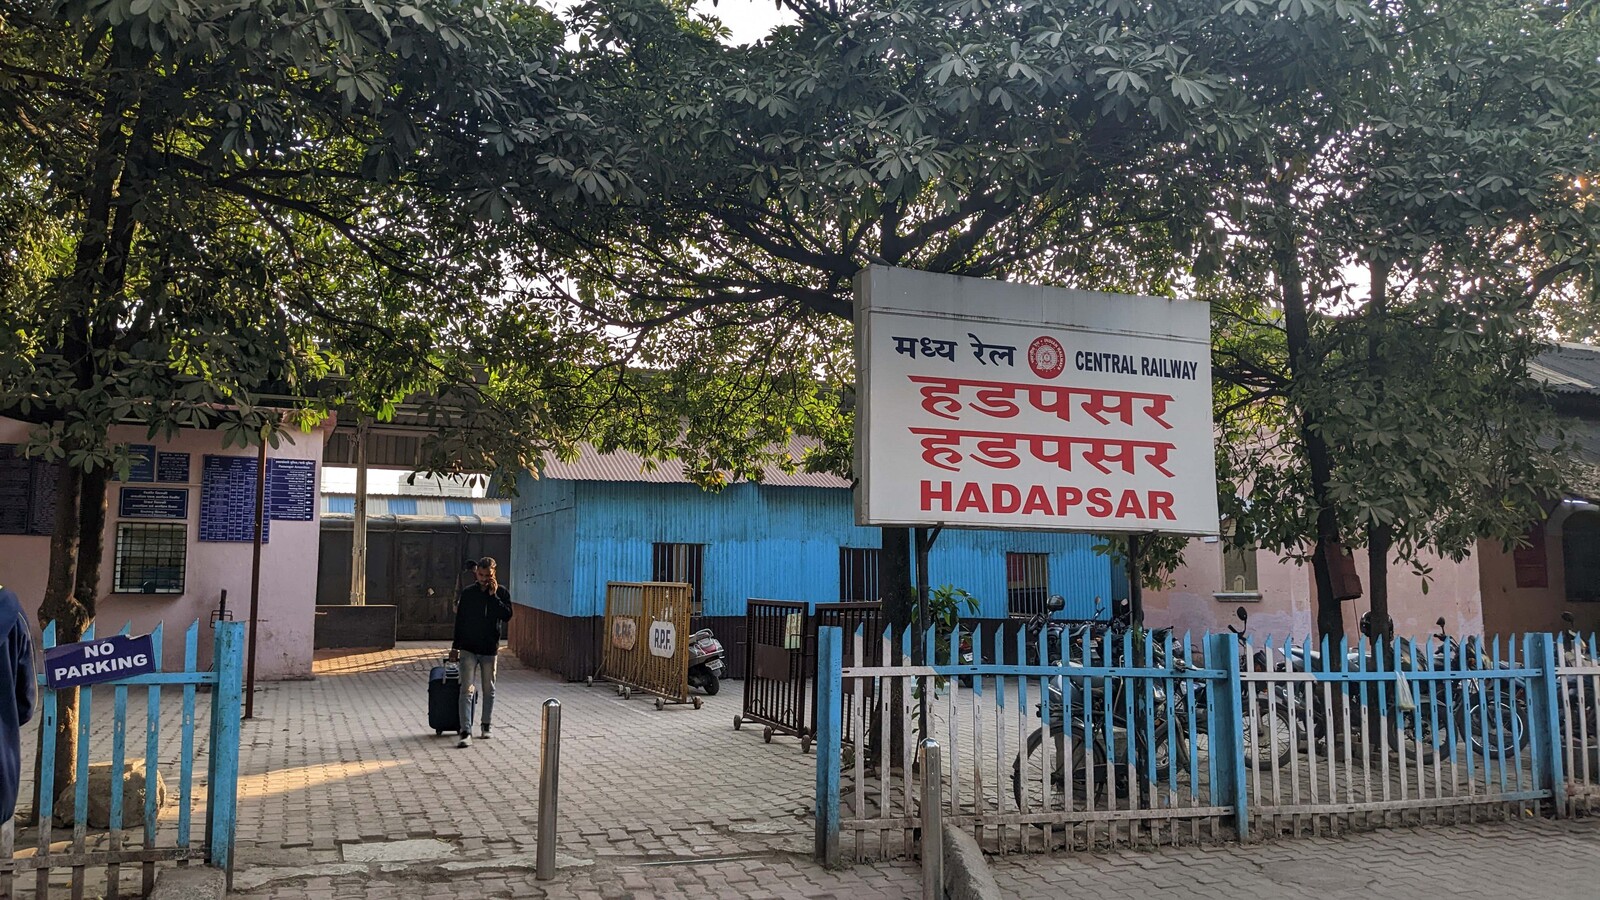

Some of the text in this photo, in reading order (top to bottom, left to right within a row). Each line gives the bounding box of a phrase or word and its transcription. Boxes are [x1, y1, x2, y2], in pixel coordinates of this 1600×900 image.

[891, 332, 1017, 367] मध्य रेल
[1075, 350, 1198, 381] CENTRAL RAILWAY
[907, 375, 1174, 430] हडपसर
[908, 427, 1176, 478] हडपसर
[920, 480, 1177, 521] HADAPSAR
[84, 642, 115, 659] NO
[654, 628, 671, 650] R.P.F.
[54, 653, 148, 681] PARKING
